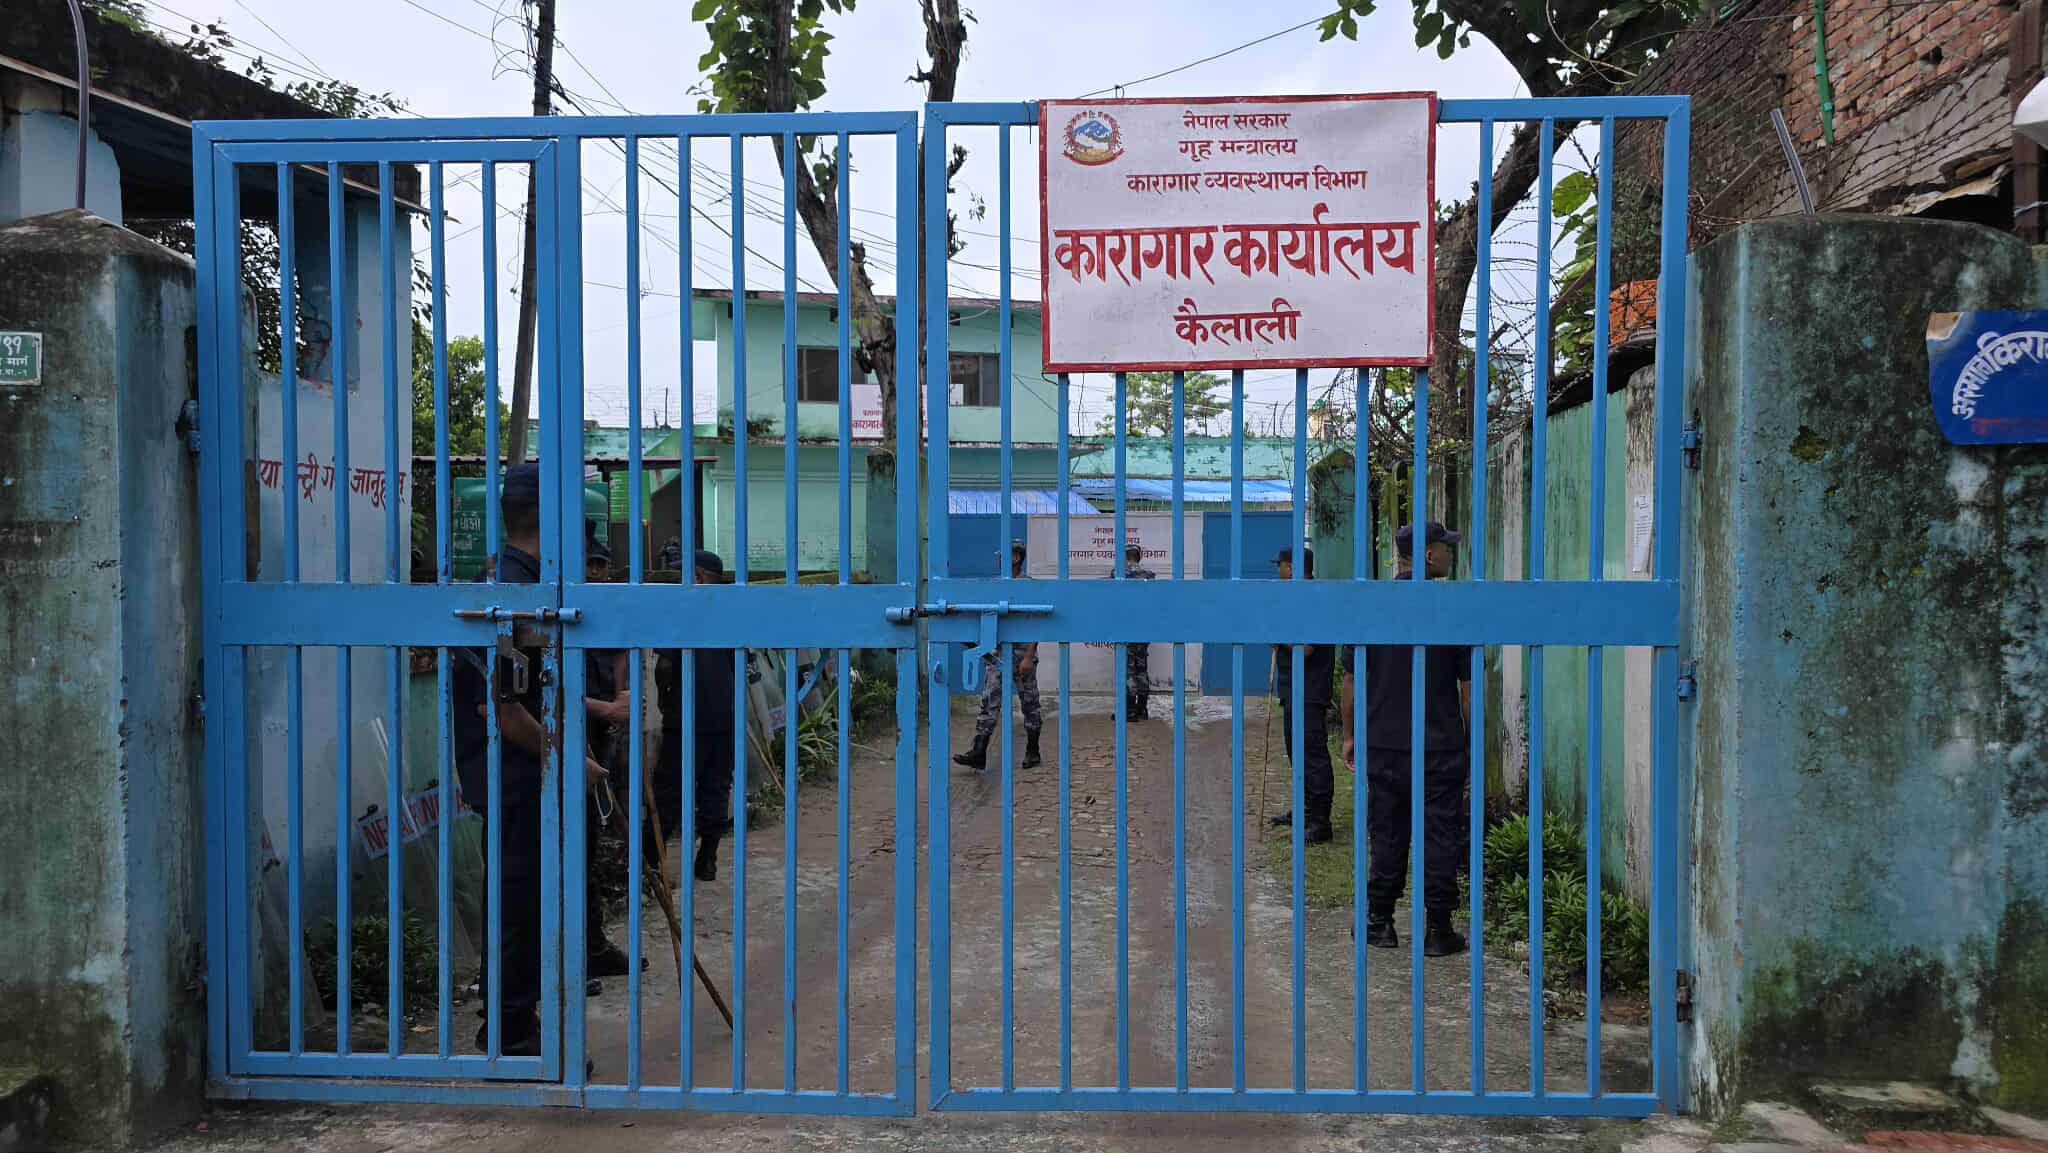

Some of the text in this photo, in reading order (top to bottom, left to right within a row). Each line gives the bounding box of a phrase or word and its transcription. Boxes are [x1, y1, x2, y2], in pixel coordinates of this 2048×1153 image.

[1183, 111, 1291, 130] नेपाल सरकार
[1178, 139, 1297, 162] गृह मन्त्रालय
[1126, 165, 1368, 195] कारागार व्यवस्थापन विभाग
[1054, 203, 1421, 286] कारागार कार्यालय
[1173, 297, 1301, 346] कैलाली
[260, 459, 282, 489] या
